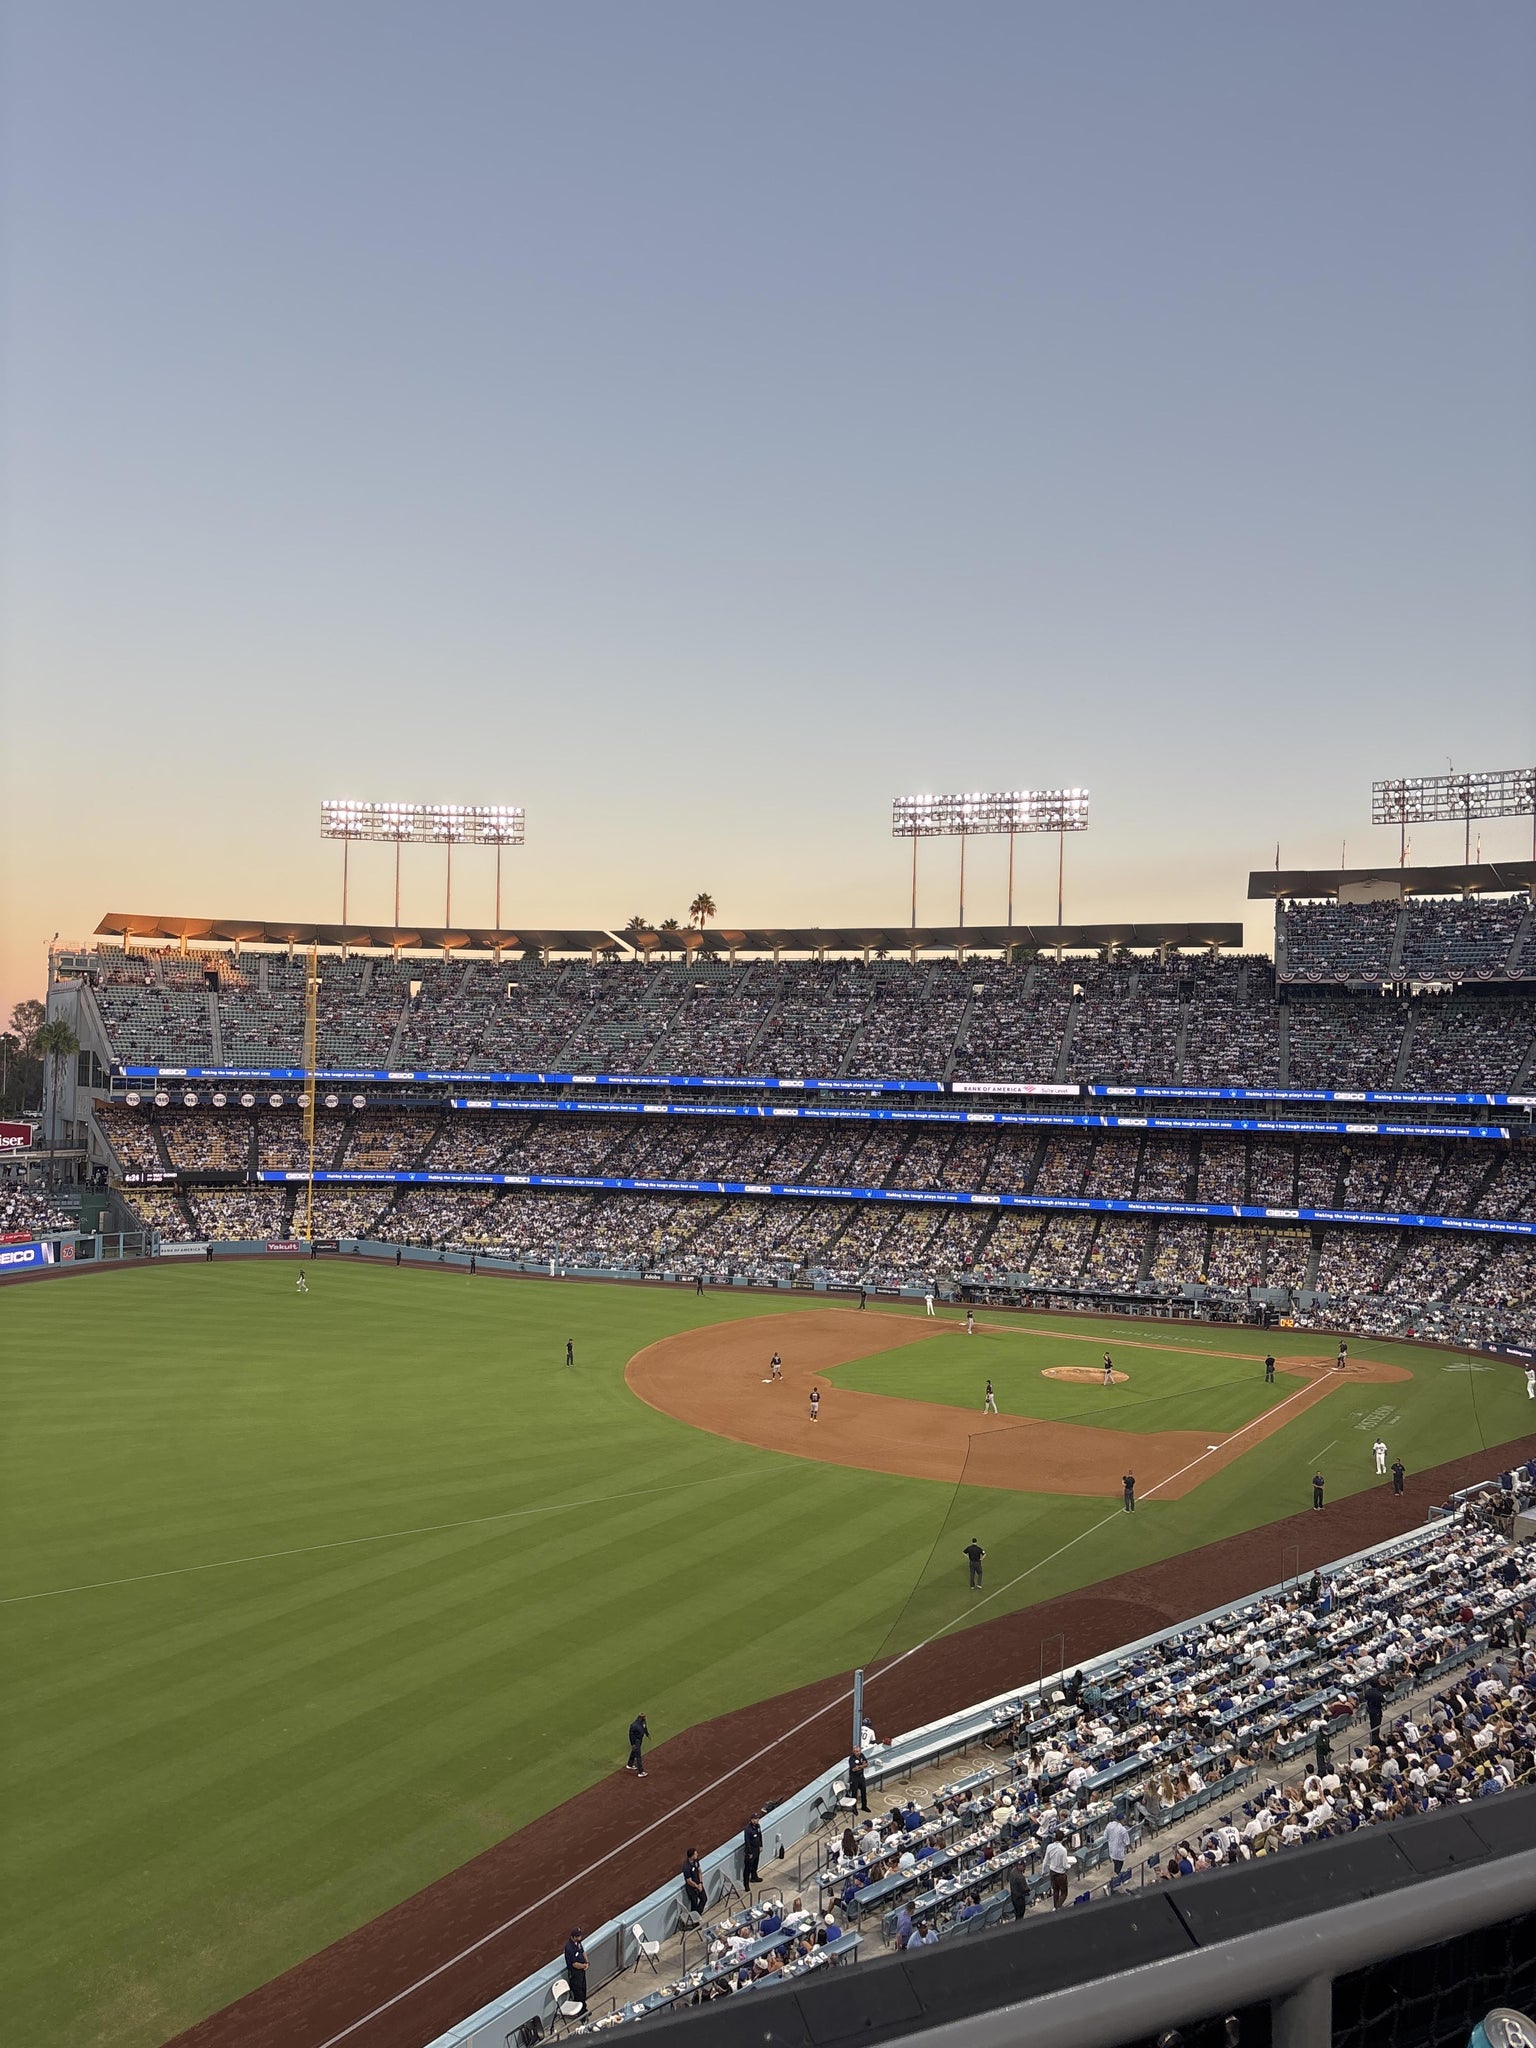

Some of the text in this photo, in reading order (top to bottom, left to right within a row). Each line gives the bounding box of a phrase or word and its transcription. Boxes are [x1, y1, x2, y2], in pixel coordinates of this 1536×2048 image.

[0, 1134, 24, 1146] iser.
[1266, 1209, 1299, 1217] GEICO
[0, 1250, 34, 1264] EICO
[63, 1248, 73, 1257] 76
